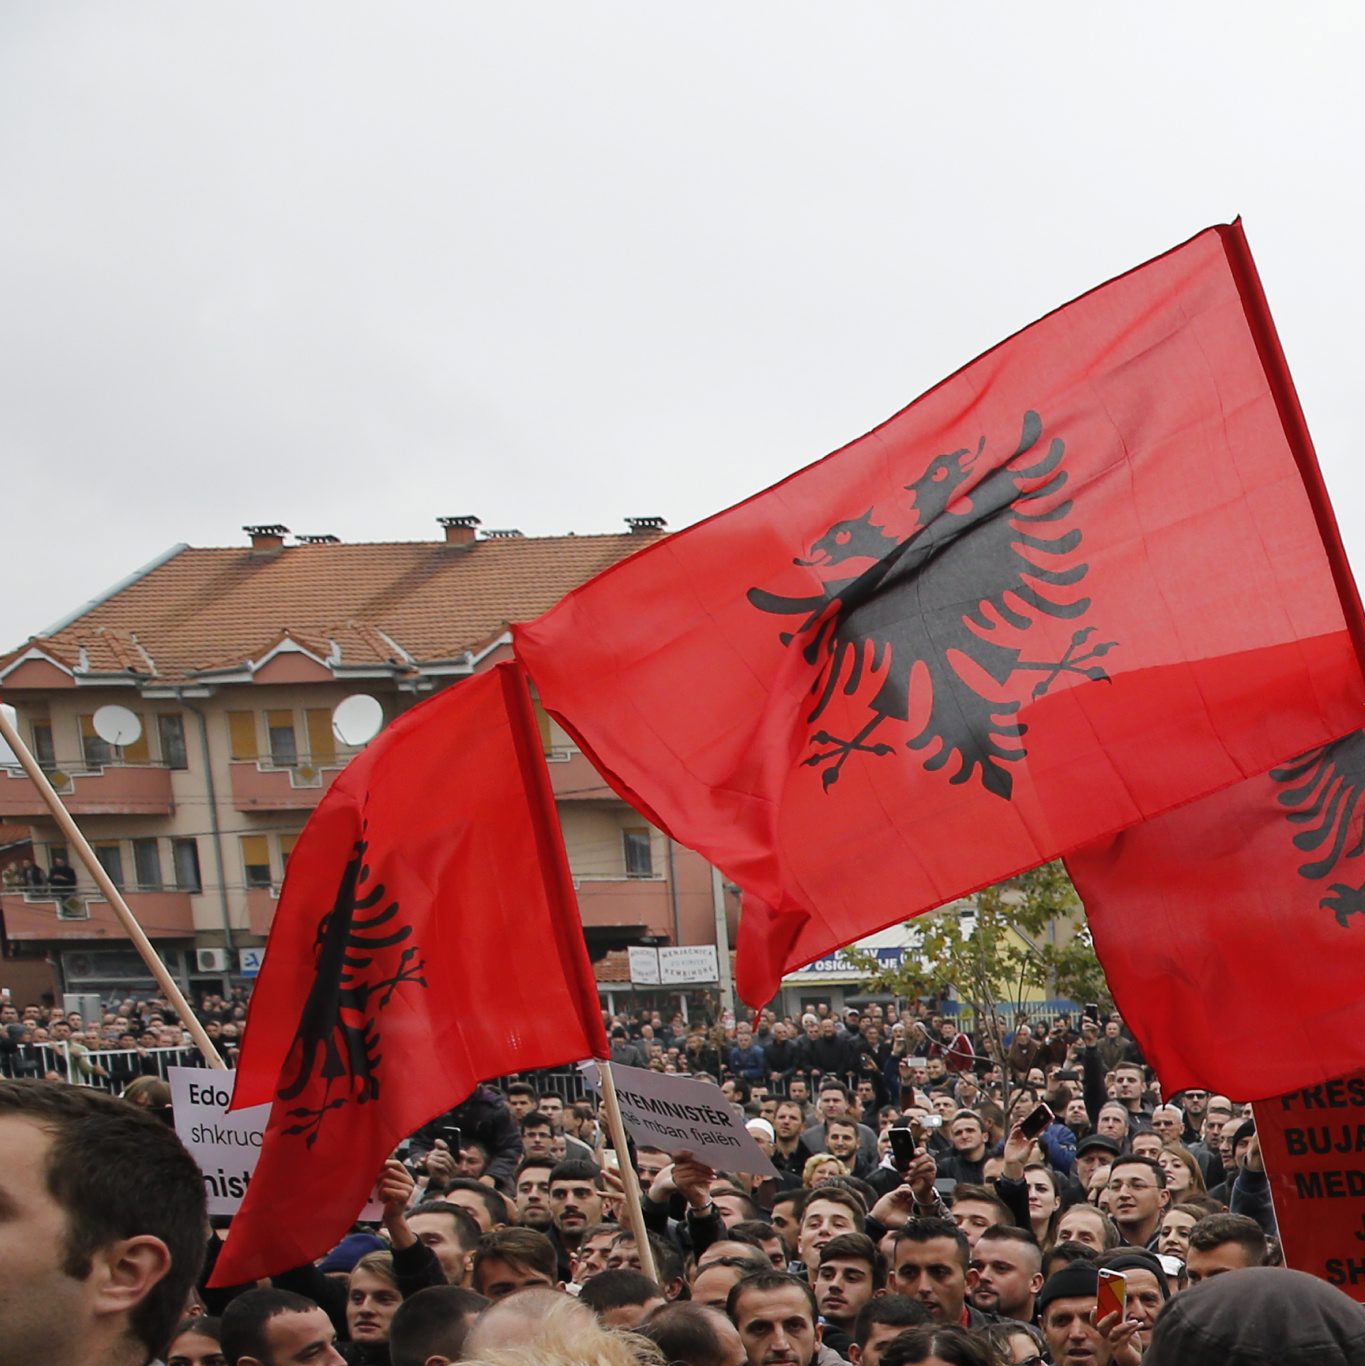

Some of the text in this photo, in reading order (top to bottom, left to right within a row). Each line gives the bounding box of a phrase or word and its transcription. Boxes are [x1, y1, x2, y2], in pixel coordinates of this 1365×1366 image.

[615, 1088, 733, 1128] RYEMINISTËR
[643, 1118, 689, 1140] mban
[690, 1127, 741, 1148] fjalën
